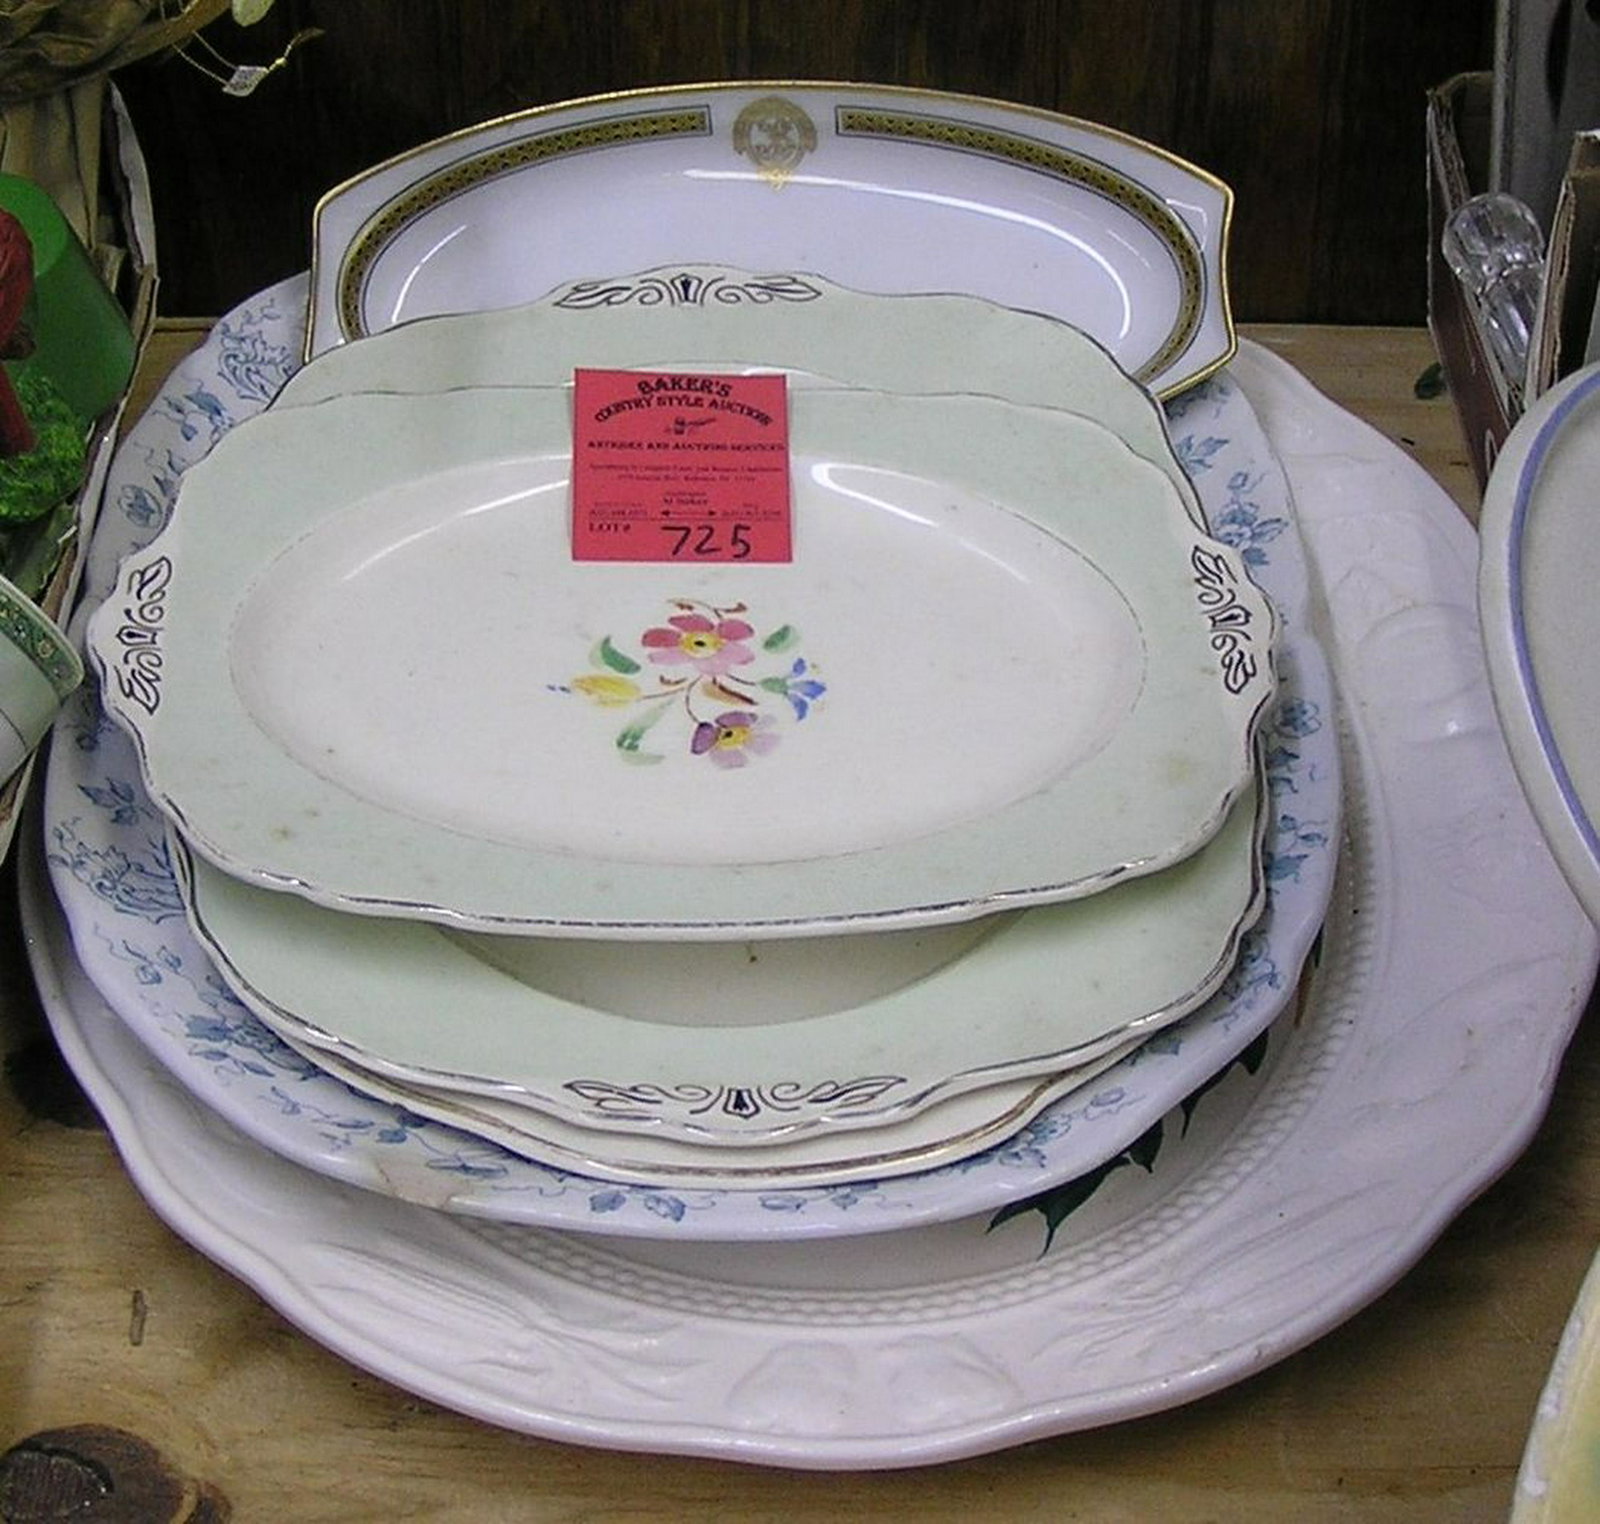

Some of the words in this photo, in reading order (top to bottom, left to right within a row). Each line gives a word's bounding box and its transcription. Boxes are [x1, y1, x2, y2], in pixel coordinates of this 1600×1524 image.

[637, 377, 733, 397] BAKER'S
[657, 394, 704, 408] STYLE
[660, 523, 752, 559] 725
